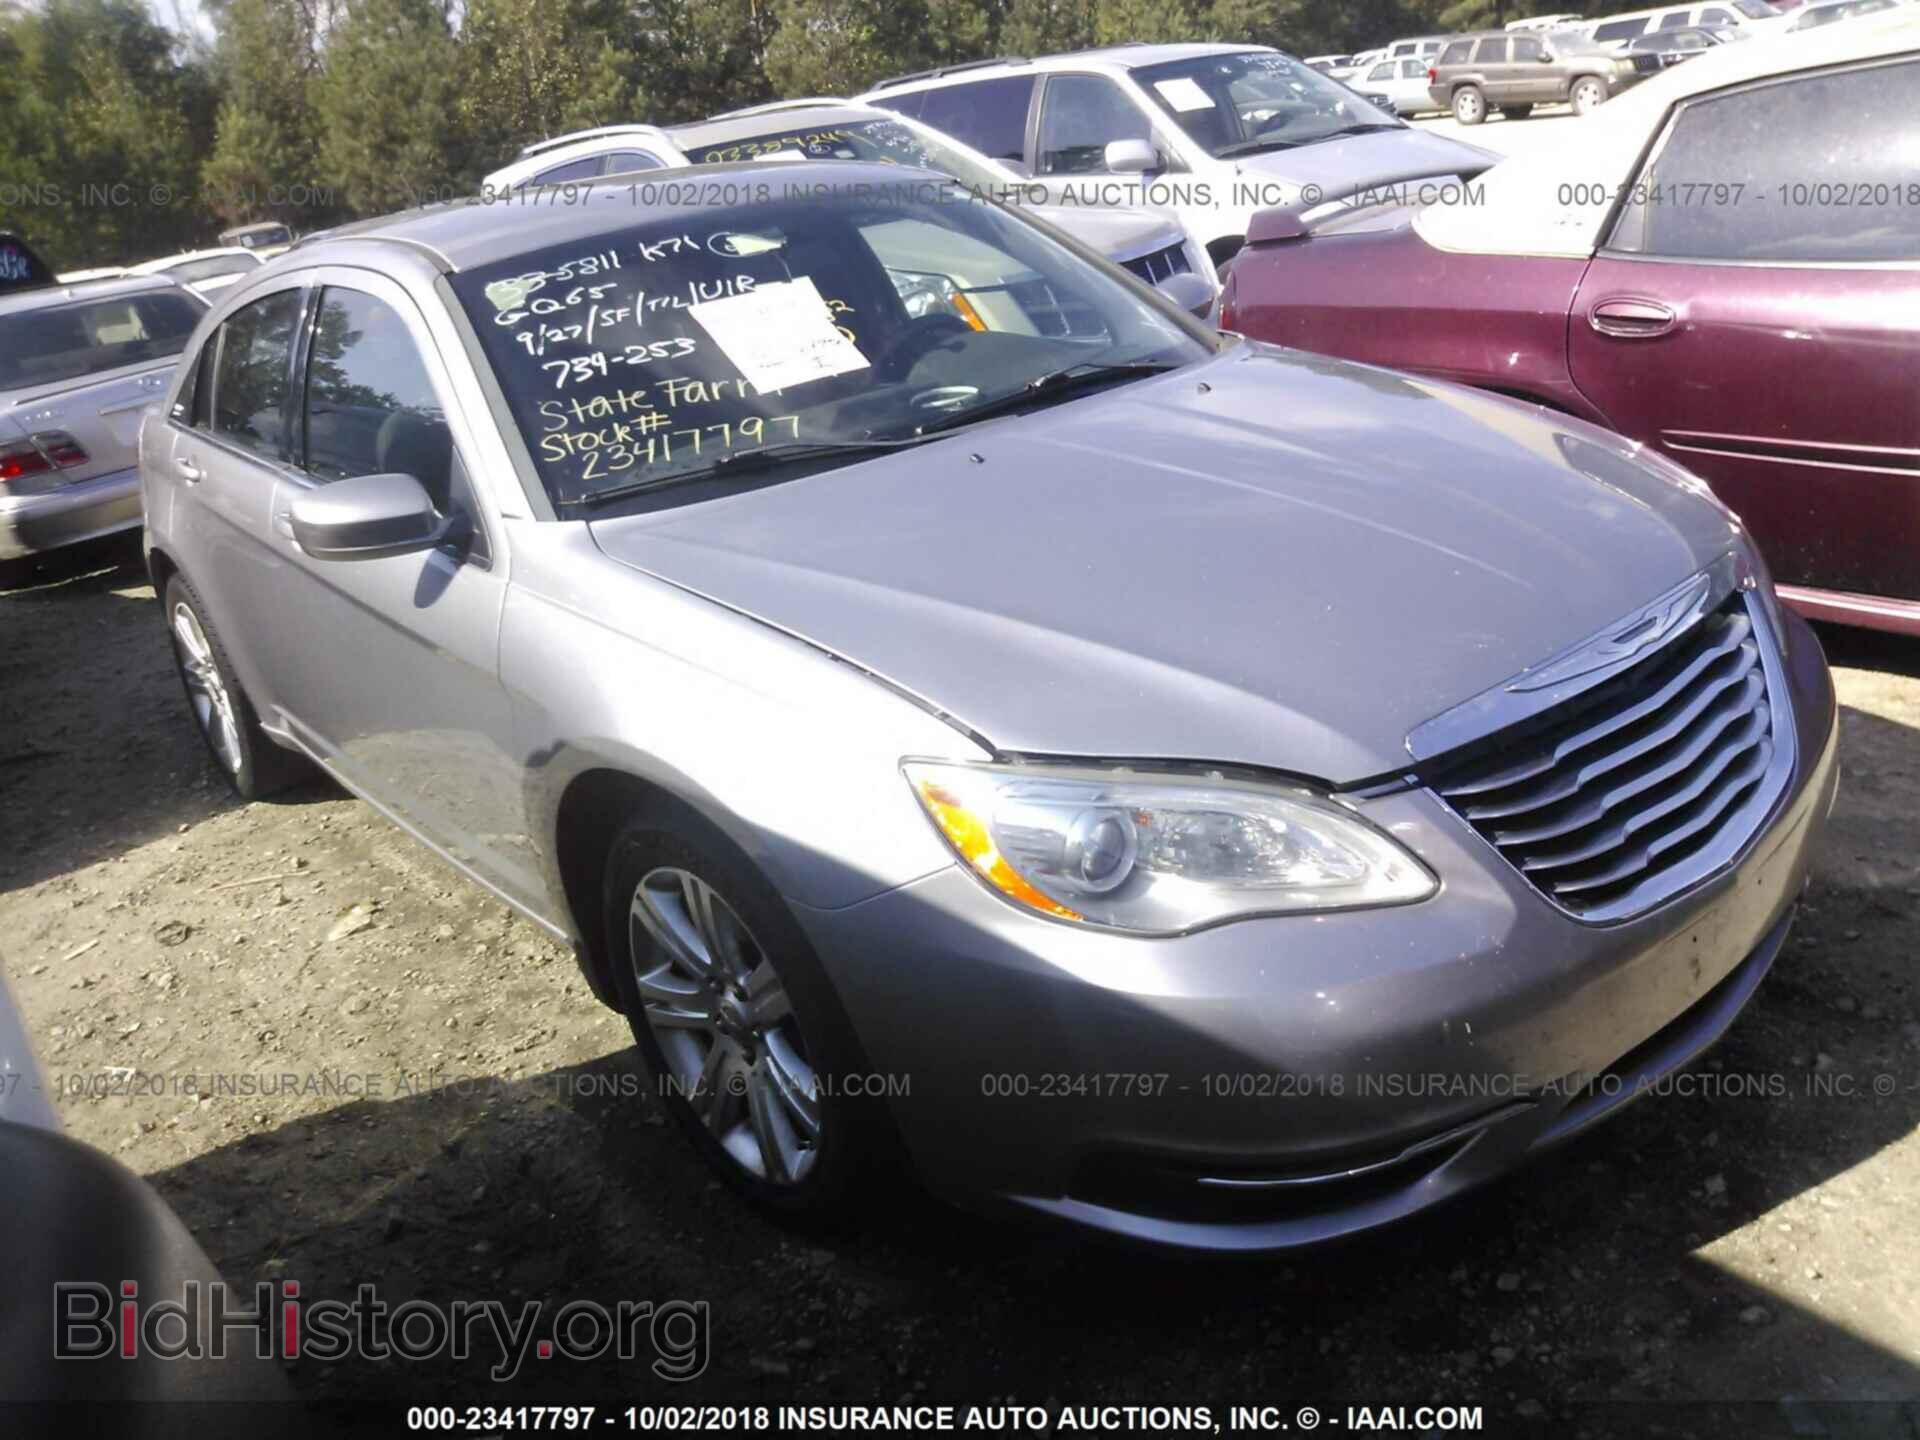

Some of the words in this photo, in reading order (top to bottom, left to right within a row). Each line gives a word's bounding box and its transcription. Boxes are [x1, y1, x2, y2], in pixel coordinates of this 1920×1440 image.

[540, 389, 654, 432] State
[540, 411, 673, 462] Stock#
[582, 416, 800, 480] 23417797
